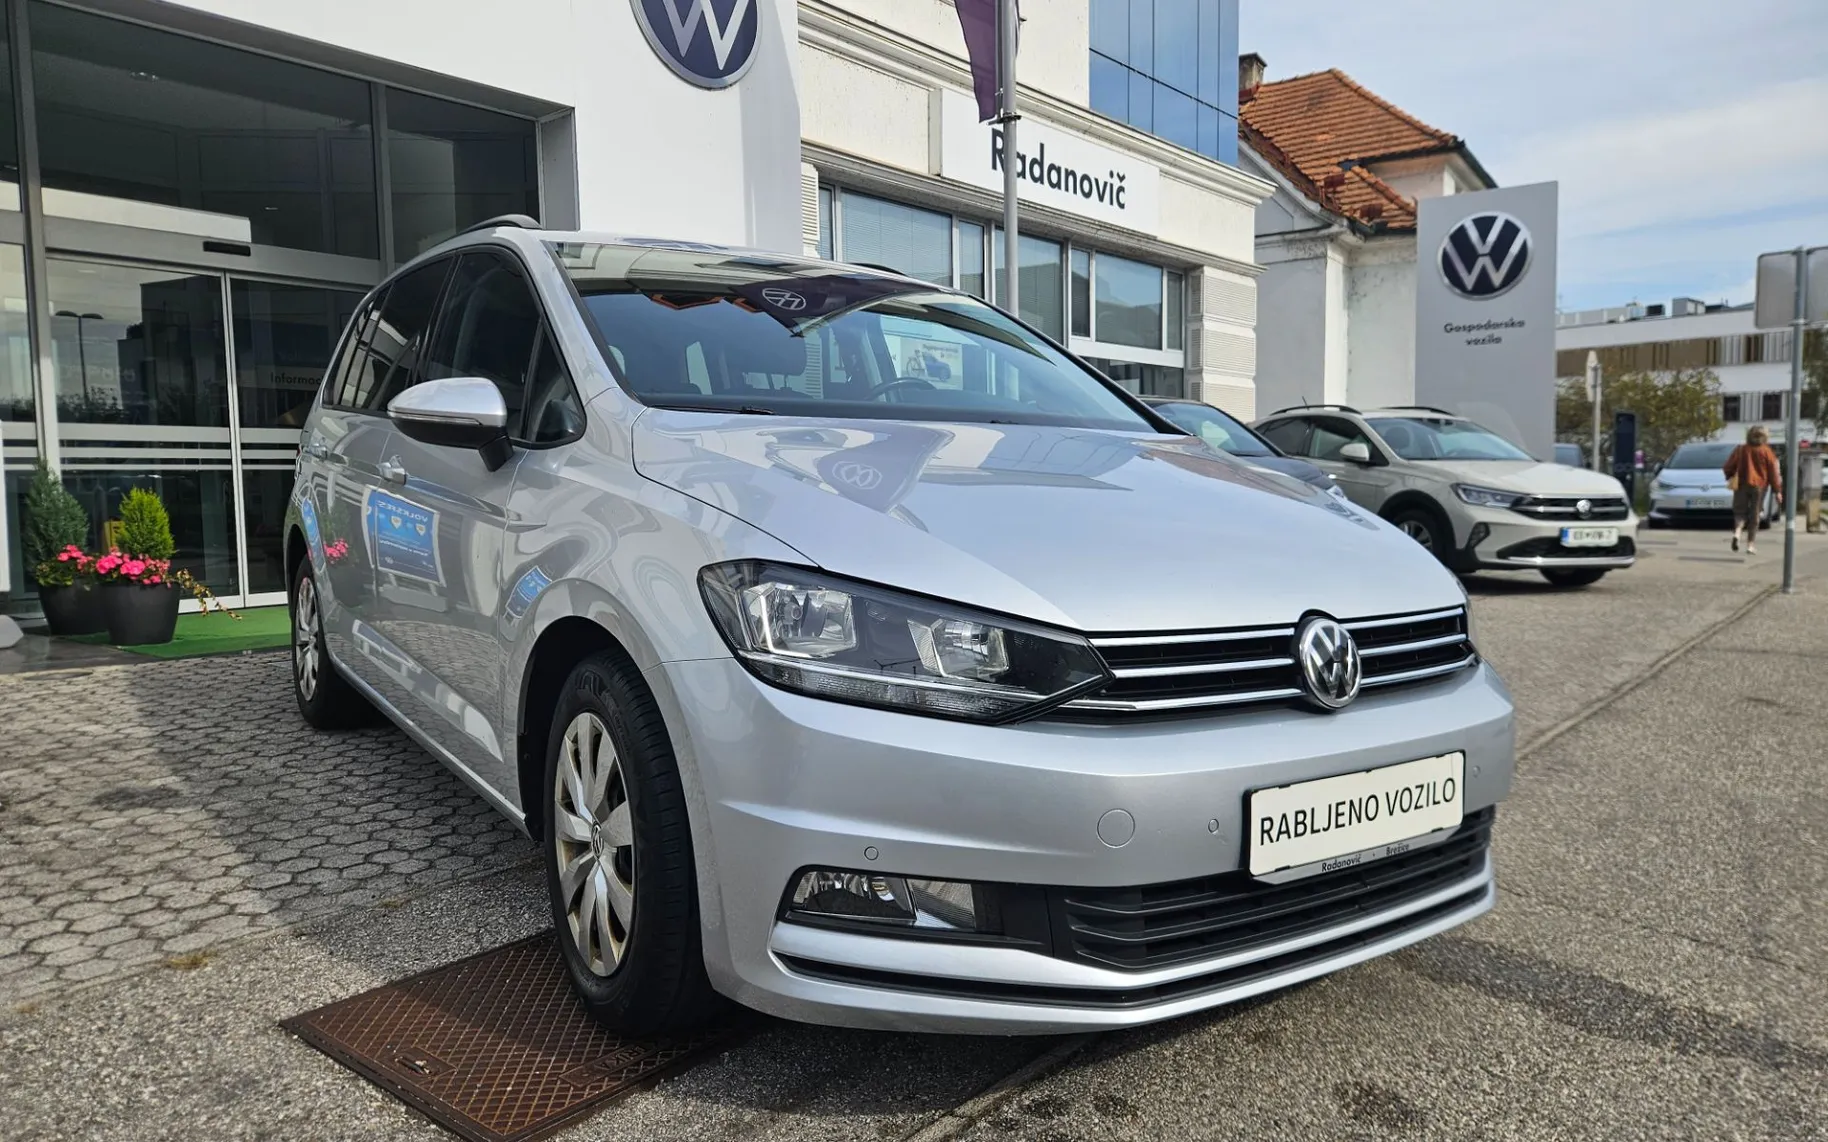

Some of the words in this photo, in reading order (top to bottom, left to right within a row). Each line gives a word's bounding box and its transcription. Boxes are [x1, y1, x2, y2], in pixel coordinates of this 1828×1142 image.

[991, 128, 1126, 210] Radanovič
[1443, 317, 1525, 334] Gospodarska
[1465, 333, 1502, 346] vozila
[270, 371, 324, 386] Informac
[1259, 794, 1379, 845] RABLJENO
[1385, 777, 1456, 816] VOZILO
